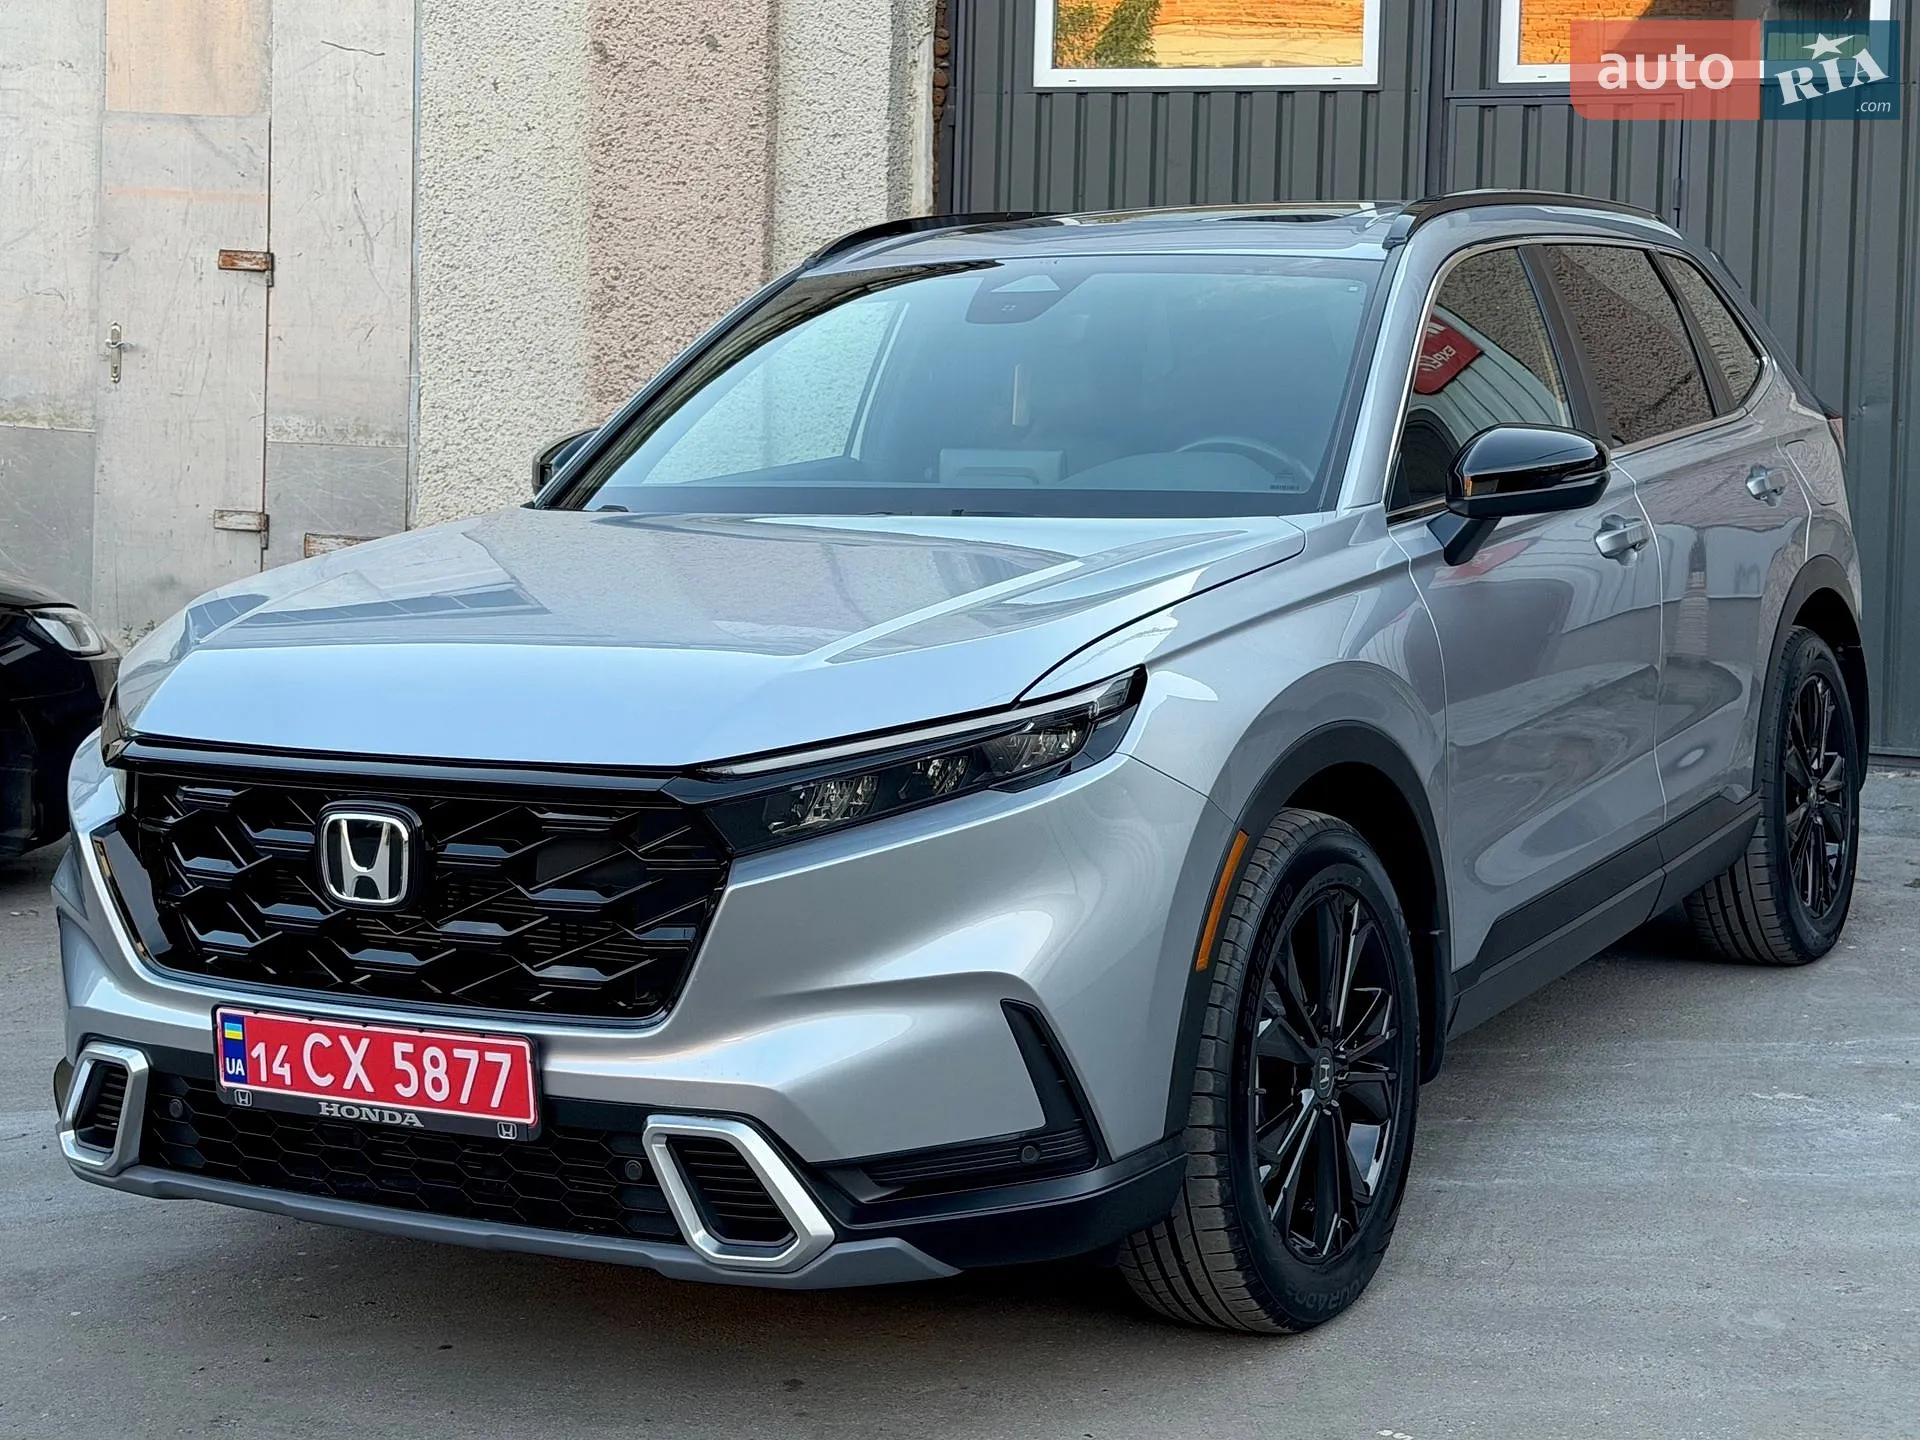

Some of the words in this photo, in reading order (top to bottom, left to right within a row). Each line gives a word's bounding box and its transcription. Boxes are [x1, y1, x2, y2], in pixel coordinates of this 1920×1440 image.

[225, 1056, 246, 1077] UA
[250, 1041, 293, 1086] 14
[303, 1031, 375, 1093] CX
[393, 1041, 512, 1109] 5877
[318, 1100, 425, 1128] HONDA
